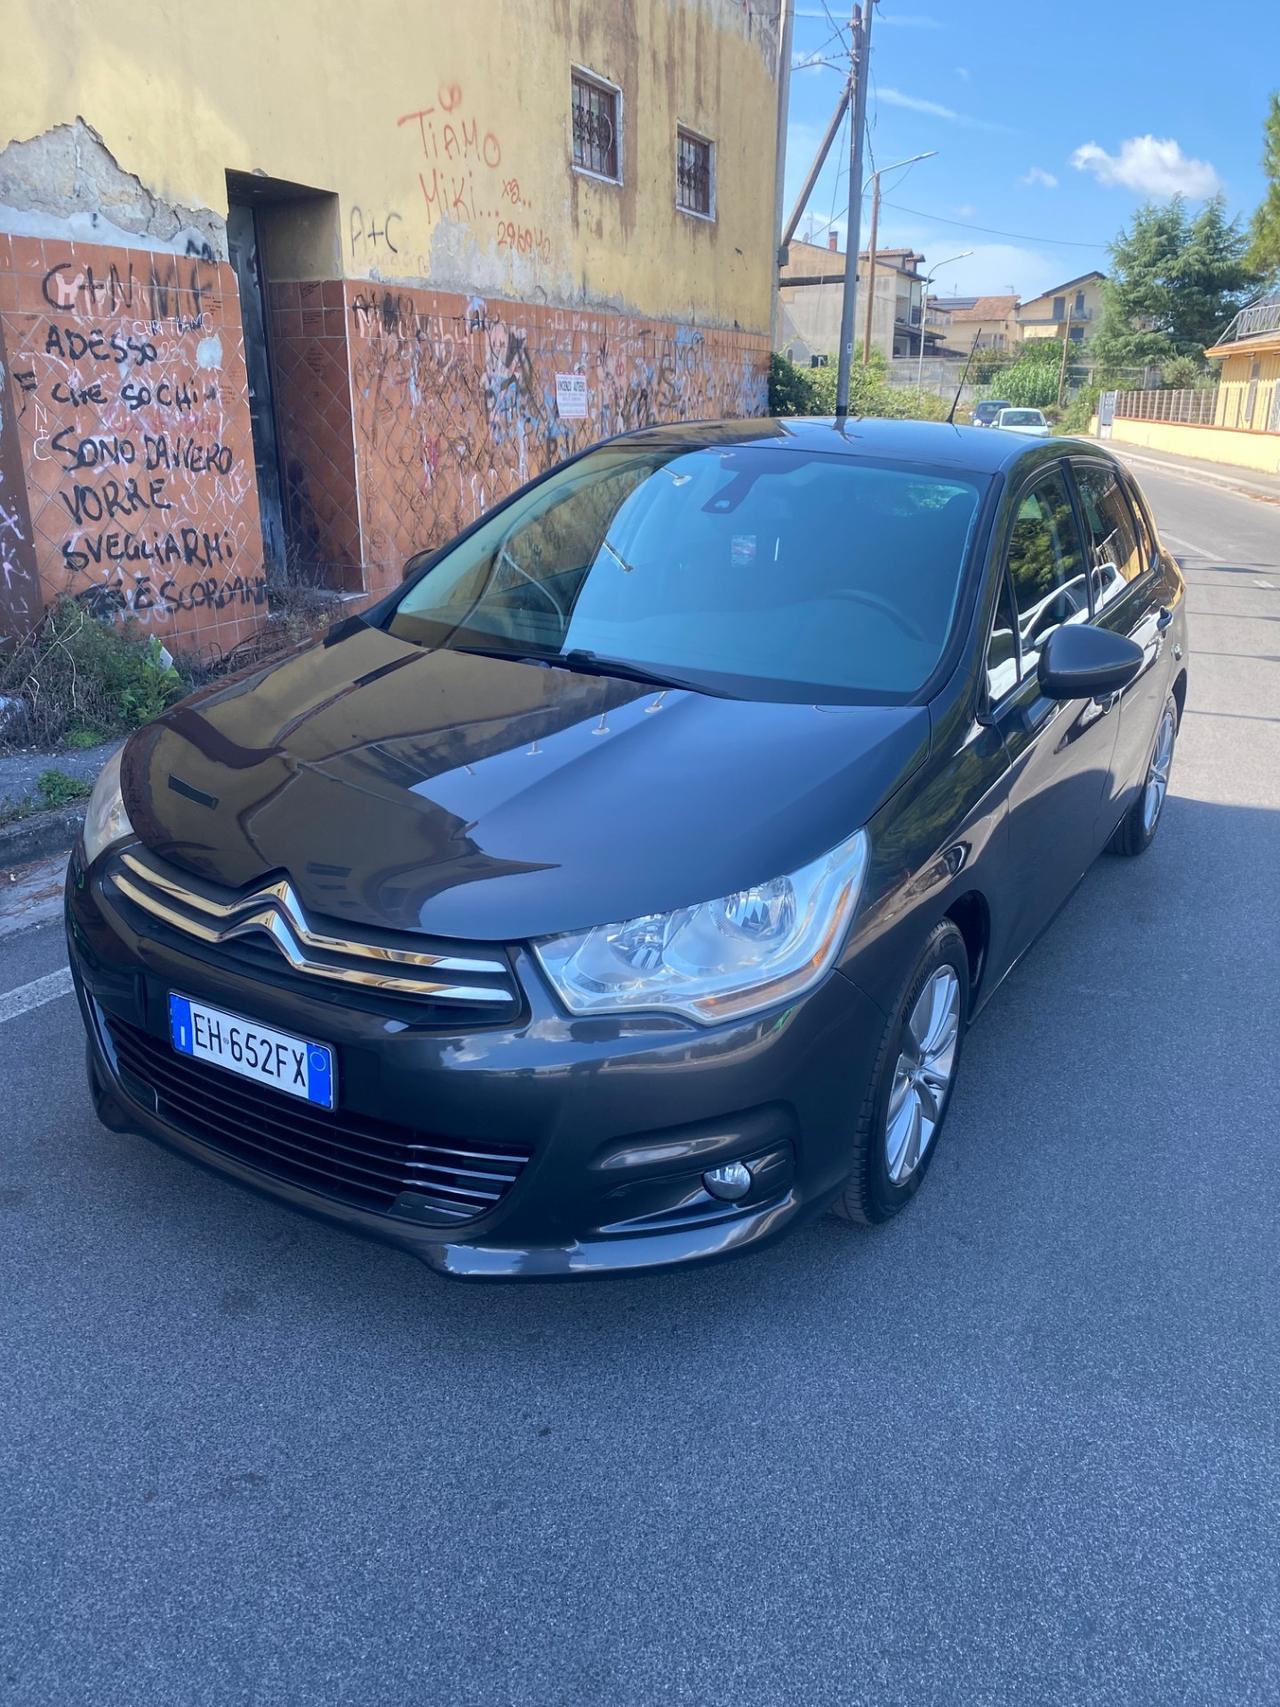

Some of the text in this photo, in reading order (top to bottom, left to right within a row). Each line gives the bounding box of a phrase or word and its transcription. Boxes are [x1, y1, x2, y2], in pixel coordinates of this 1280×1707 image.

[45, 323, 158, 367] ADESSO
[51, 425, 234, 475] SONO DAVVERO
